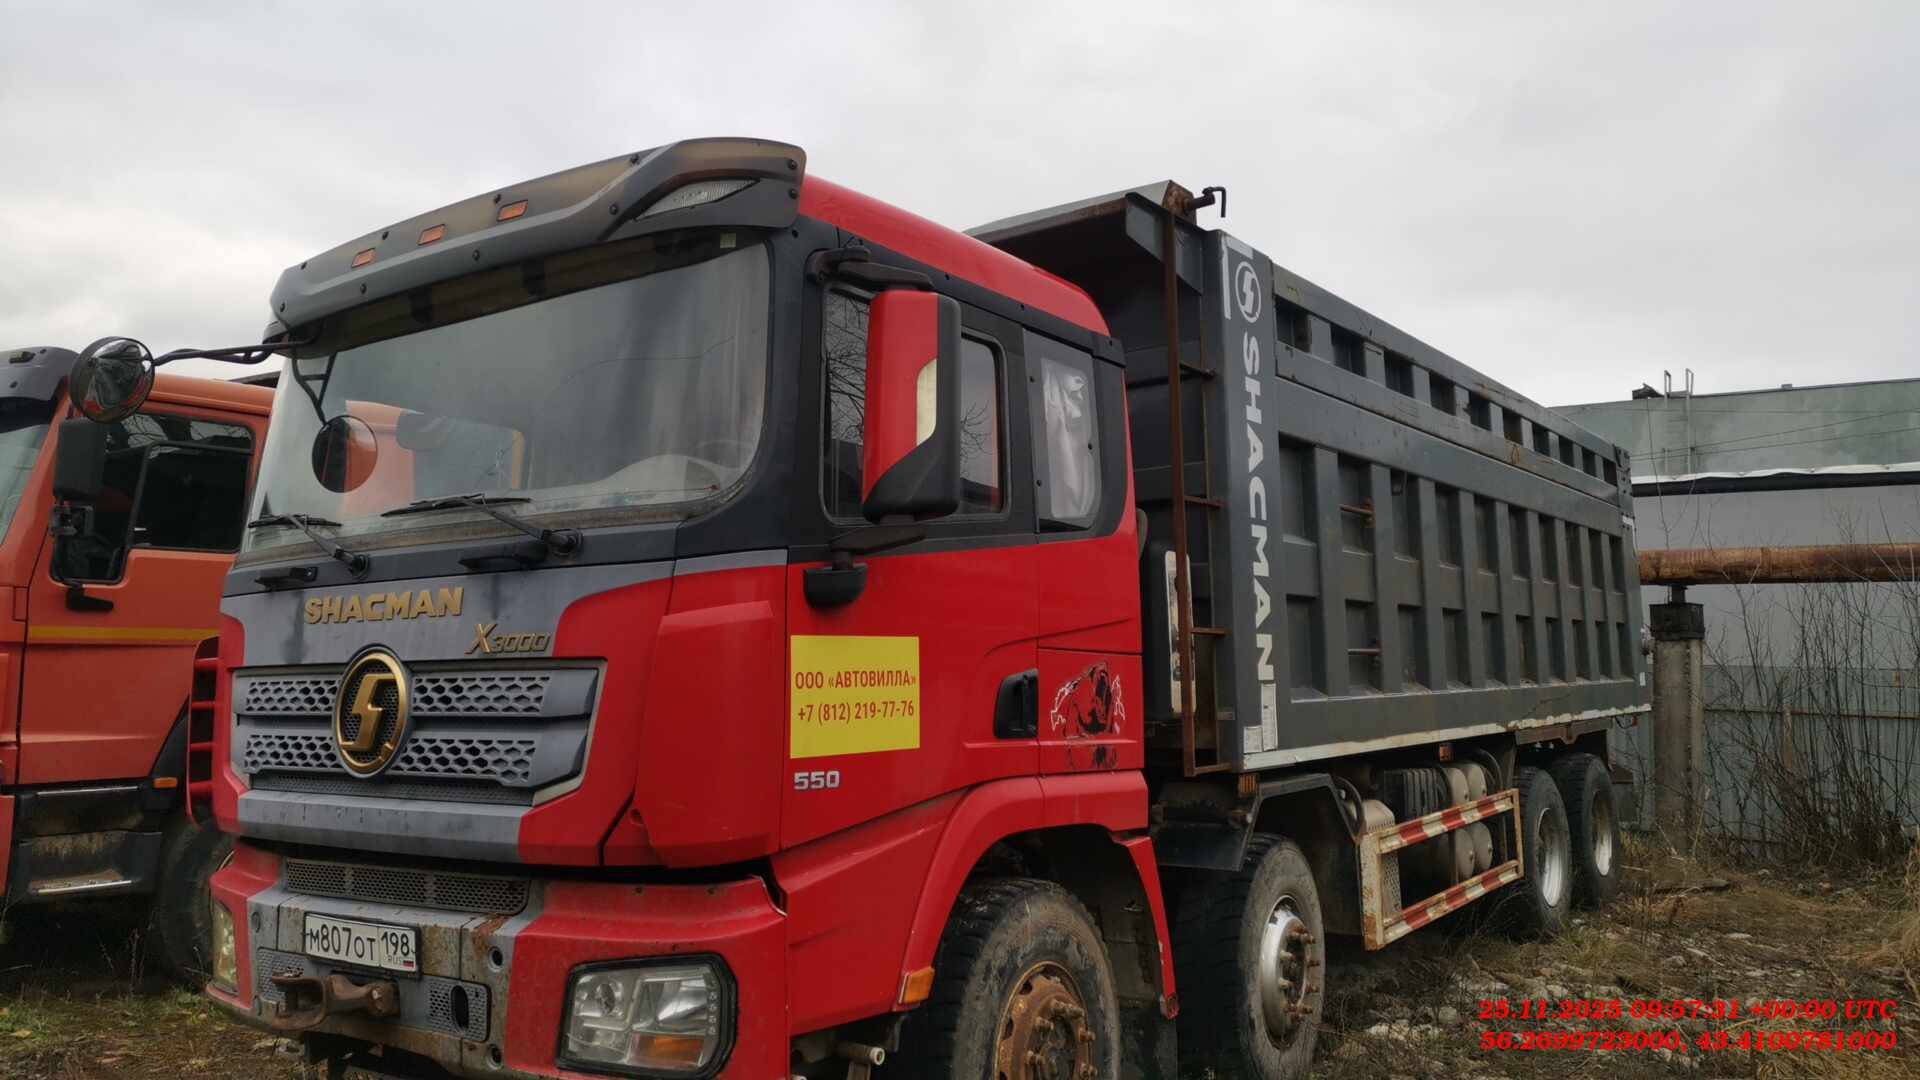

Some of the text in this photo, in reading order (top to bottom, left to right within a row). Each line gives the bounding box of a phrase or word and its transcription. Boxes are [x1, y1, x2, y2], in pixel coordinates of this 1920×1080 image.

[1242, 331, 1274, 681] SHACMAN
[304, 586, 464, 624] SHACMAN
[464, 622, 552, 654] X3000
[795, 670, 916, 689] ООО «АВТОВИЛЛА»
[798, 700, 914, 726] +7 (812) 219-77-76
[794, 770, 840, 790] 550
[381, 931, 409, 957] 198
